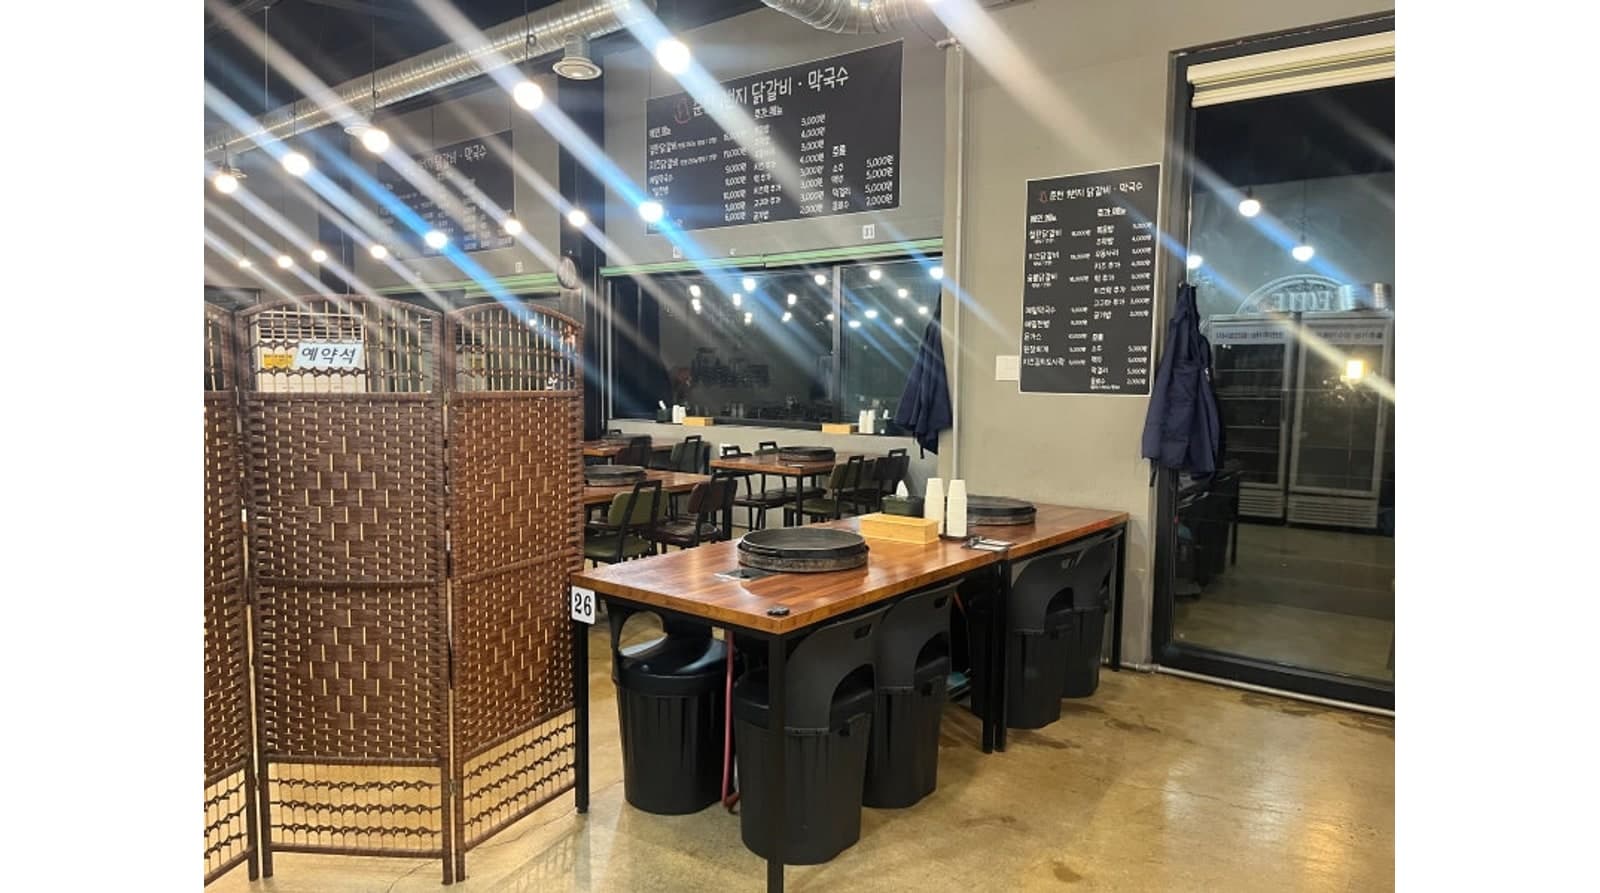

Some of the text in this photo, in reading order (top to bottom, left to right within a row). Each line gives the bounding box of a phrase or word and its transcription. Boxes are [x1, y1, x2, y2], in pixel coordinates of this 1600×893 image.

[751, 76, 792, 105] 닭갈비
[808, 66, 849, 92] 막국수
[801, 113, 826, 126] 3,000원
[866, 154, 894, 168] 5,000원
[865, 167, 894, 179] 5,000원
[865, 181, 893, 193] 5,000원
[1086, 185, 1112, 198] 닭갈비
[1119, 181, 1143, 192] 막국수
[301, 346, 356, 364] 예약석
[574, 592, 592, 617] 26
